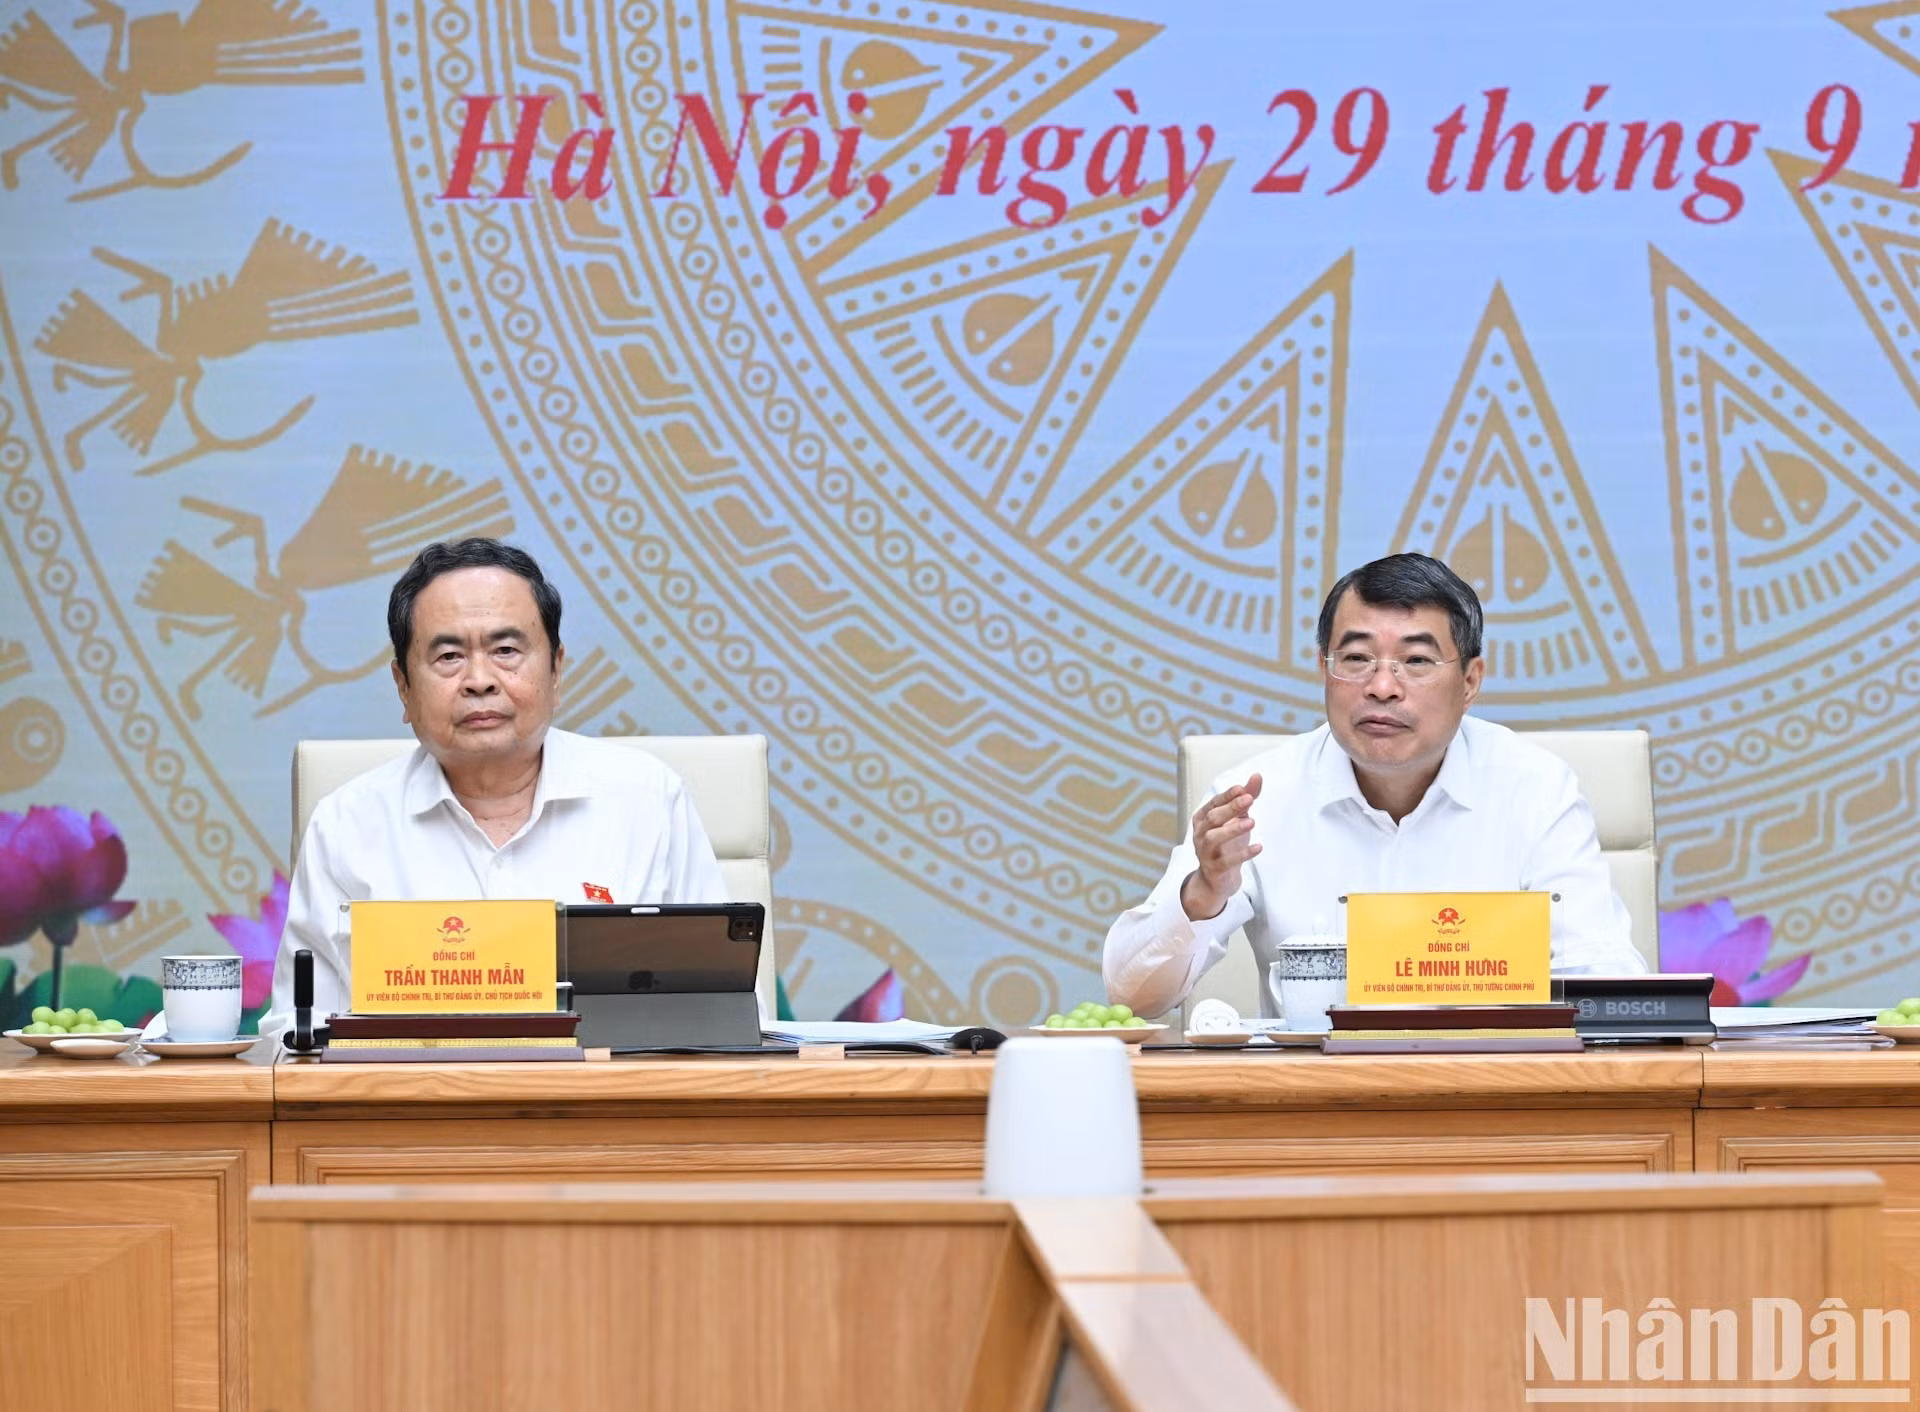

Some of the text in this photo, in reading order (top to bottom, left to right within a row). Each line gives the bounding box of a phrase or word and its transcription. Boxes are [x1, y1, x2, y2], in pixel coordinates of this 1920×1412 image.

[436, 93, 615, 201] Hà
[648, 92, 892, 231] Nội,
[936, 88, 1216, 229] ngày
[1252, 87, 1390, 196] 29
[1427, 84, 1760, 225] tháng
[1800, 83, 1862, 192] 9
[384, 962, 524, 986] TRẦN THANH MẪN
[1395, 957, 1508, 977] LÊ MINH HƯNG
[1605, 1001, 1666, 1015] BOSCH
